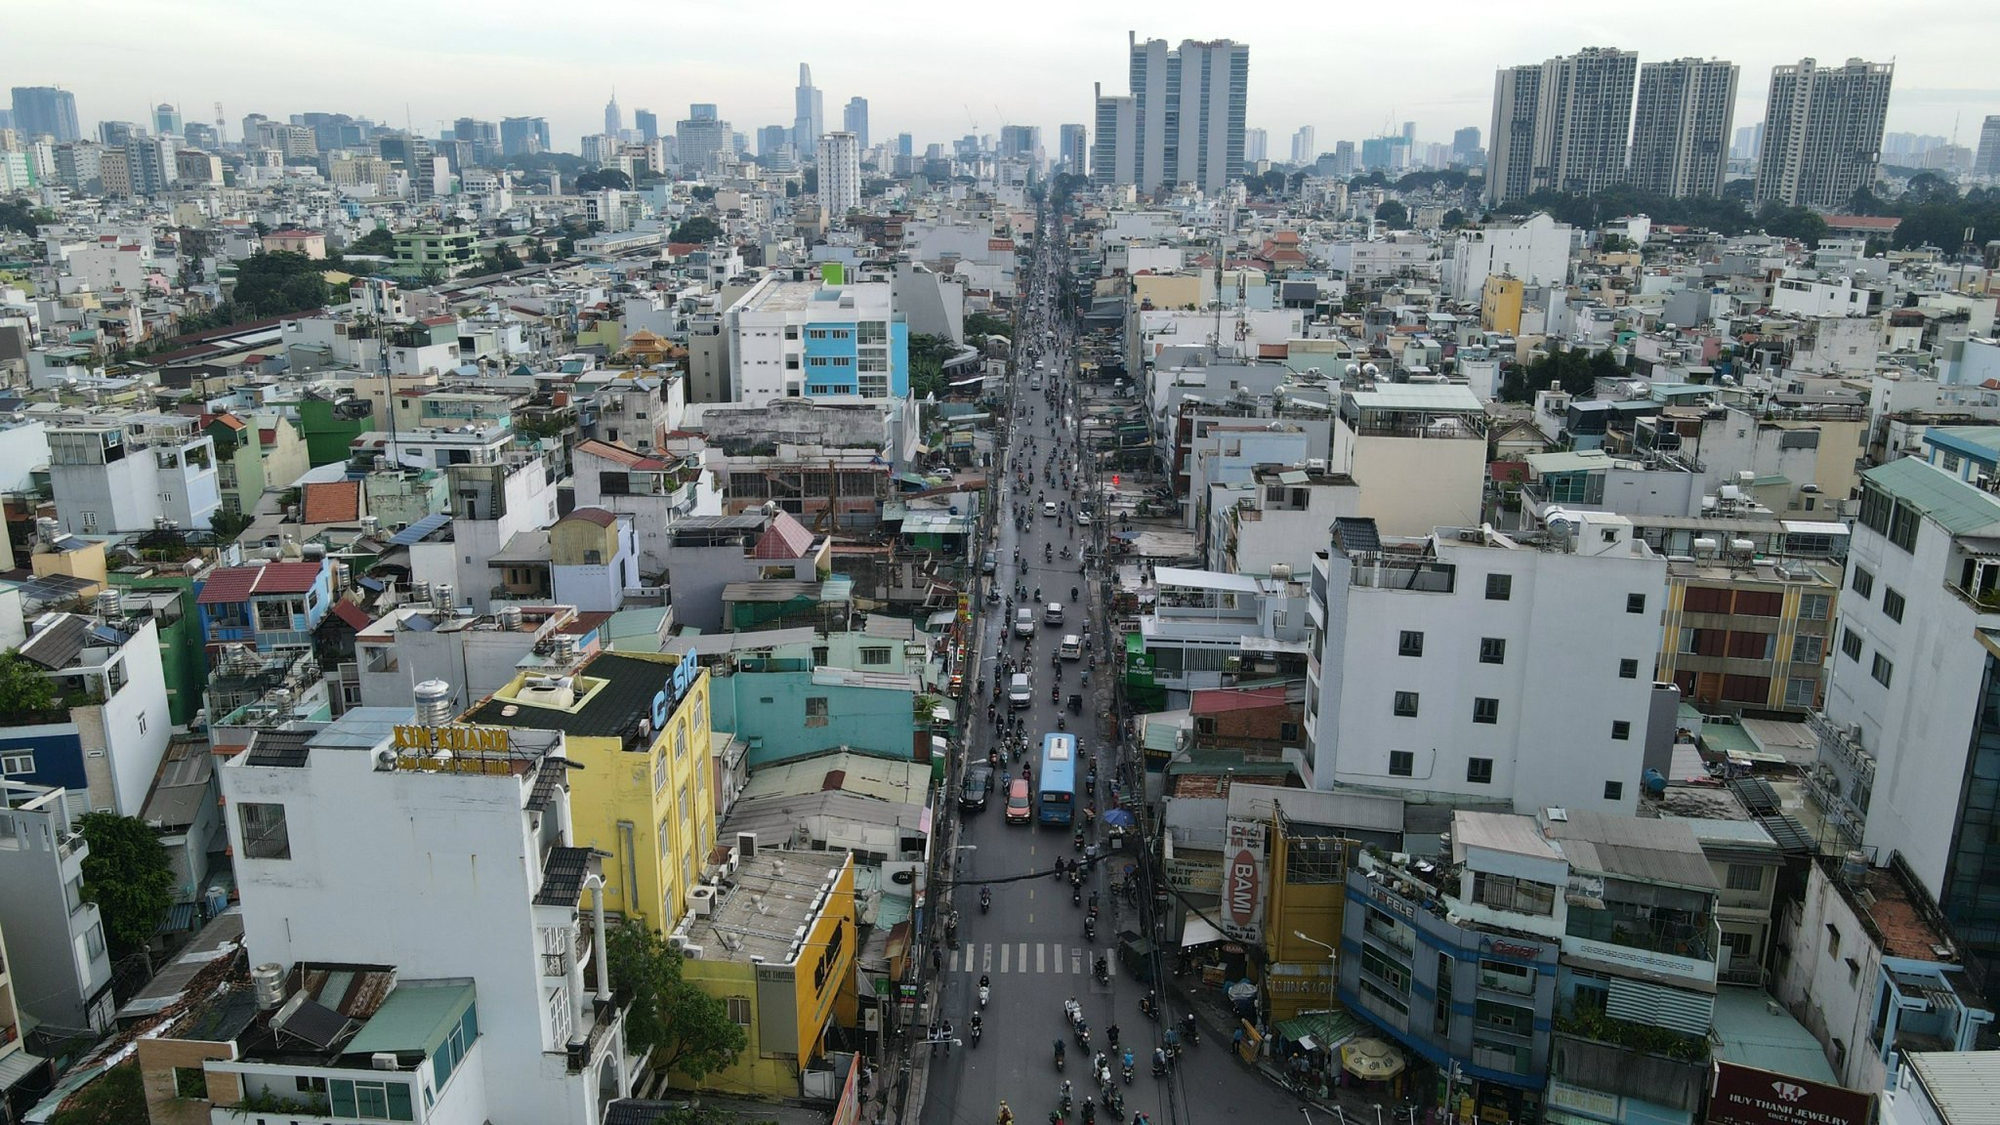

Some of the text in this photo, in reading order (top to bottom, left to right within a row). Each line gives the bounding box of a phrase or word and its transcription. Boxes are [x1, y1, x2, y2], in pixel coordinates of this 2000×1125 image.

[393, 724, 432, 749] KIM
[1233, 863, 1254, 914] BAMI
[1729, 1093, 1850, 1125] HUY THANH JEWELRY
[1767, 1111, 1788, 1122] SINCE
